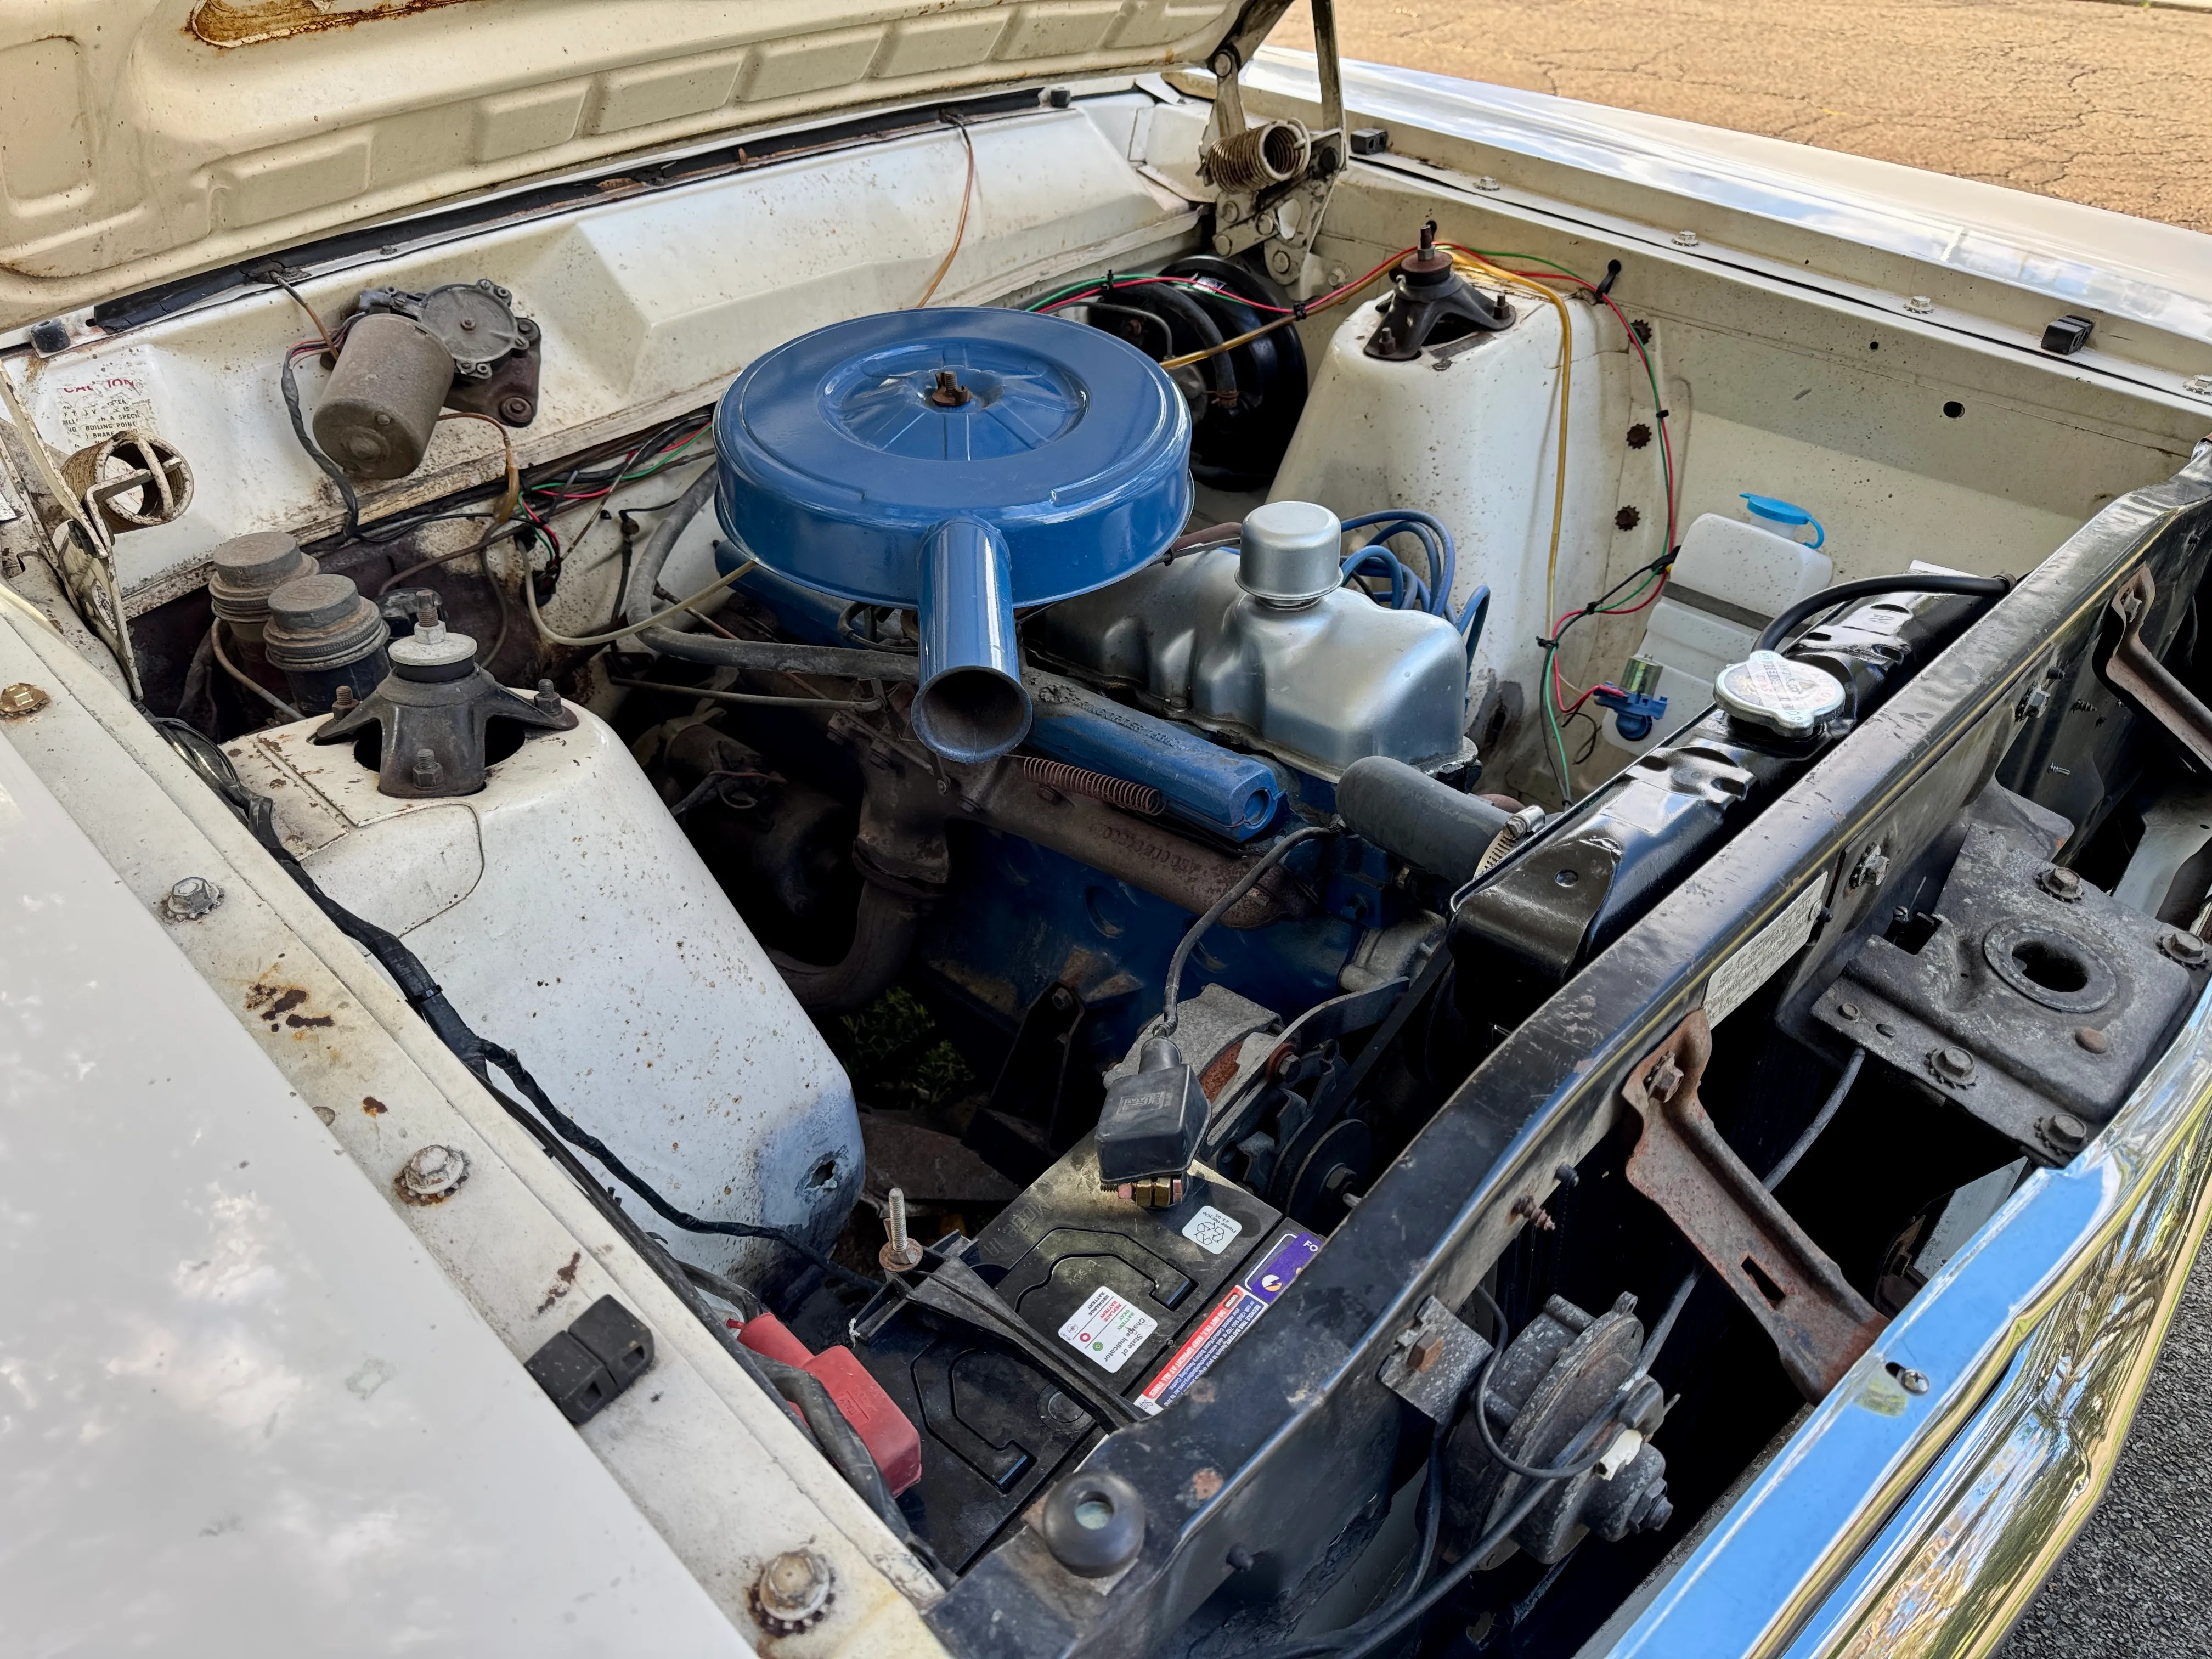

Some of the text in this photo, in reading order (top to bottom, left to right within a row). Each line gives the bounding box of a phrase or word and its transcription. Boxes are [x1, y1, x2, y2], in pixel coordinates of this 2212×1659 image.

[64, 379, 137, 393] CAUION
[1202, 1211, 1237, 1233] Please Recycle
[1302, 1239, 1319, 1254] FO
[1086, 1291, 1105, 1310] BATTERY
[1087, 1294, 1109, 1317] RECHARGE
[1098, 1300, 1117, 1319] BATTERY
[1103, 1302, 1122, 1323] REPLACE
[1116, 1311, 1135, 1331] BATTERY
[1118, 1308, 1130, 1321] OKAY
[1244, 1304, 1261, 1322] RECYCLE
[1237, 1318, 1248, 1330] THIS
[1102, 1316, 1146, 1363] Charge Indicator
[1120, 1333, 1143, 1356] State of
[1190, 1334, 1204, 1349] KEEP
[1173, 1345, 1194, 1368] UPRIGHT
[1160, 1371, 1172, 1384] ALL
[1167, 1364, 1178, 1375] AT
[1178, 1359, 1195, 1379] Recycling
[1148, 1380, 1165, 1398] TIMES
